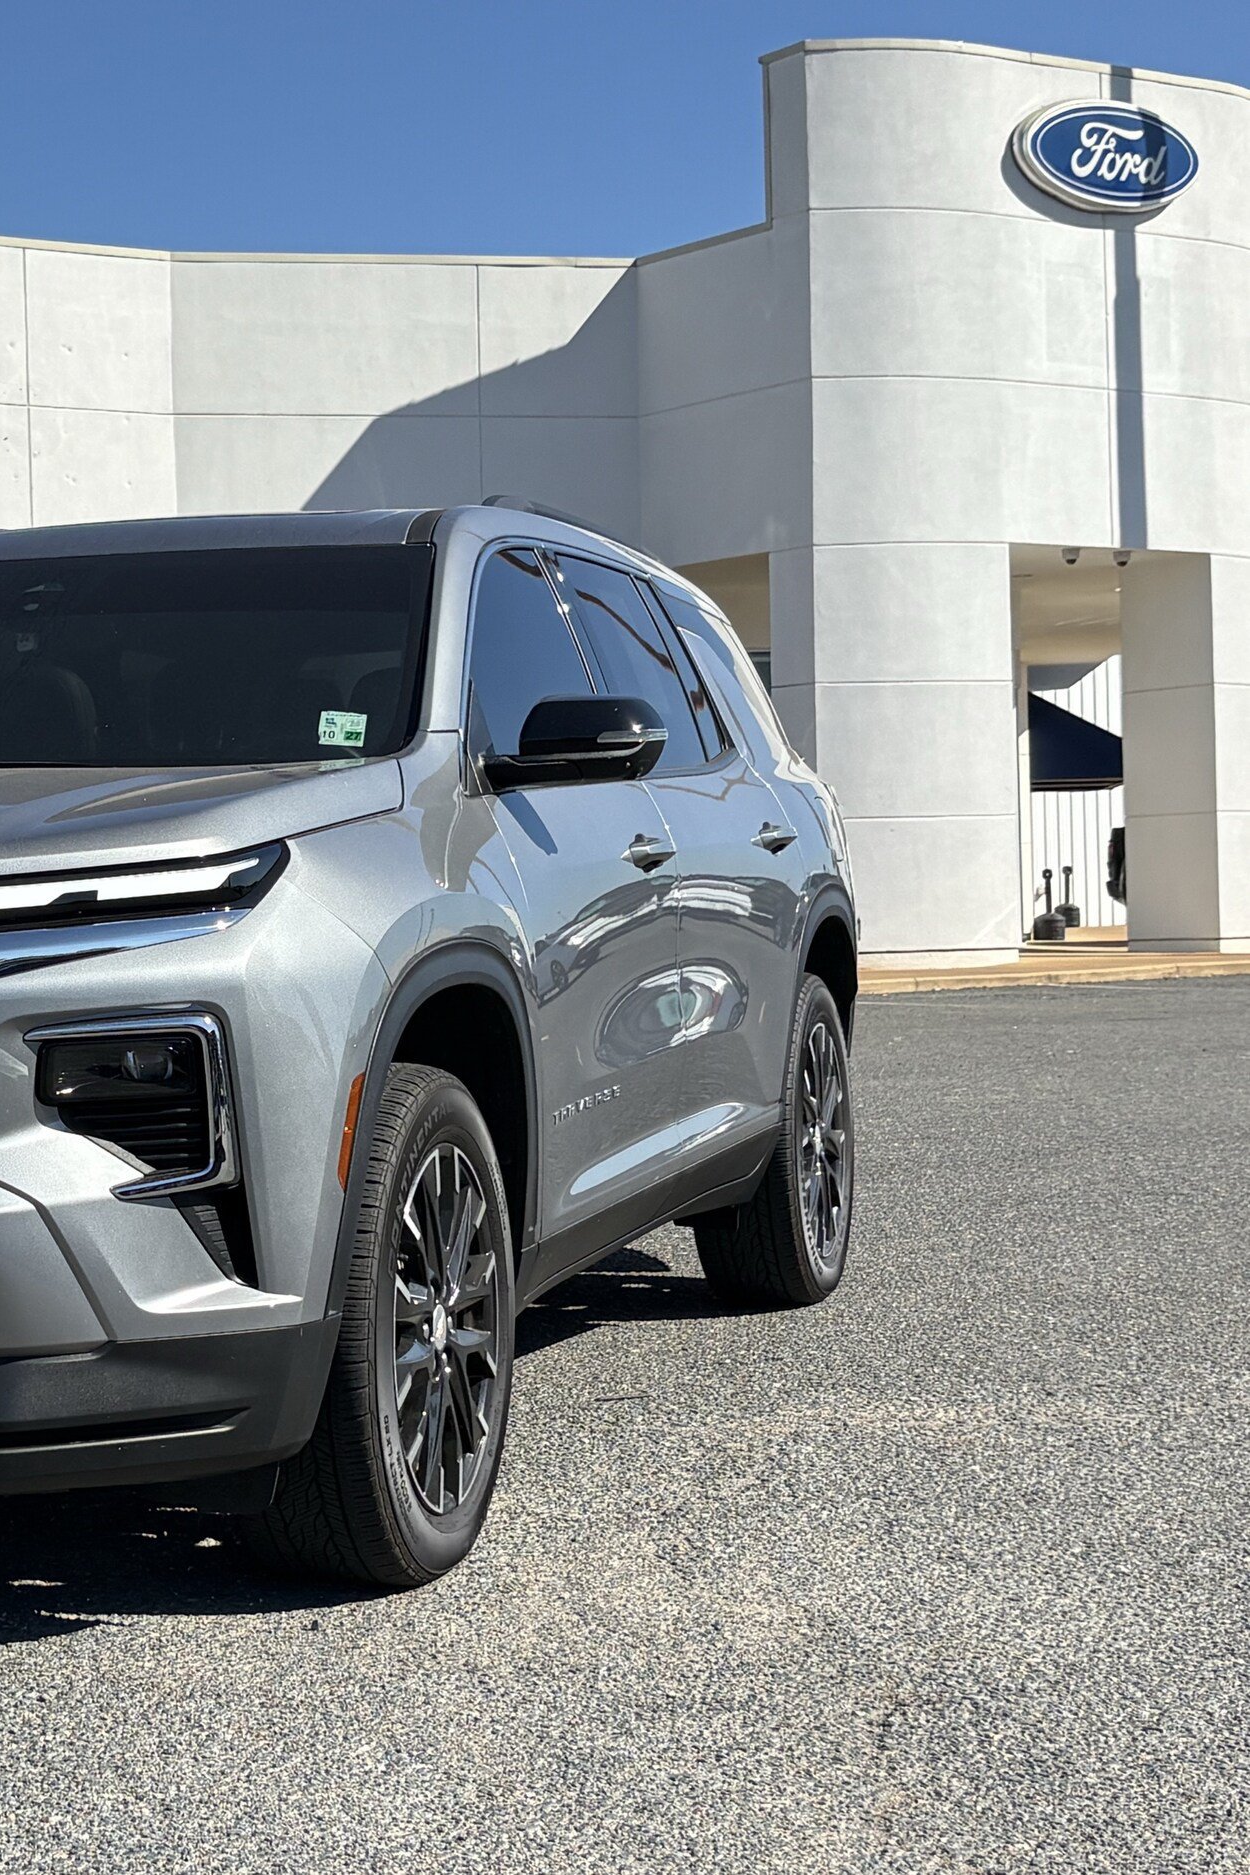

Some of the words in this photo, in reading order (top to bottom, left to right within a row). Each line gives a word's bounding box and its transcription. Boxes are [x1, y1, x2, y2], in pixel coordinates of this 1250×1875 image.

[1070, 121, 1168, 186] Ford
[323, 730, 336, 739] 10
[346, 731, 362, 741] 27
